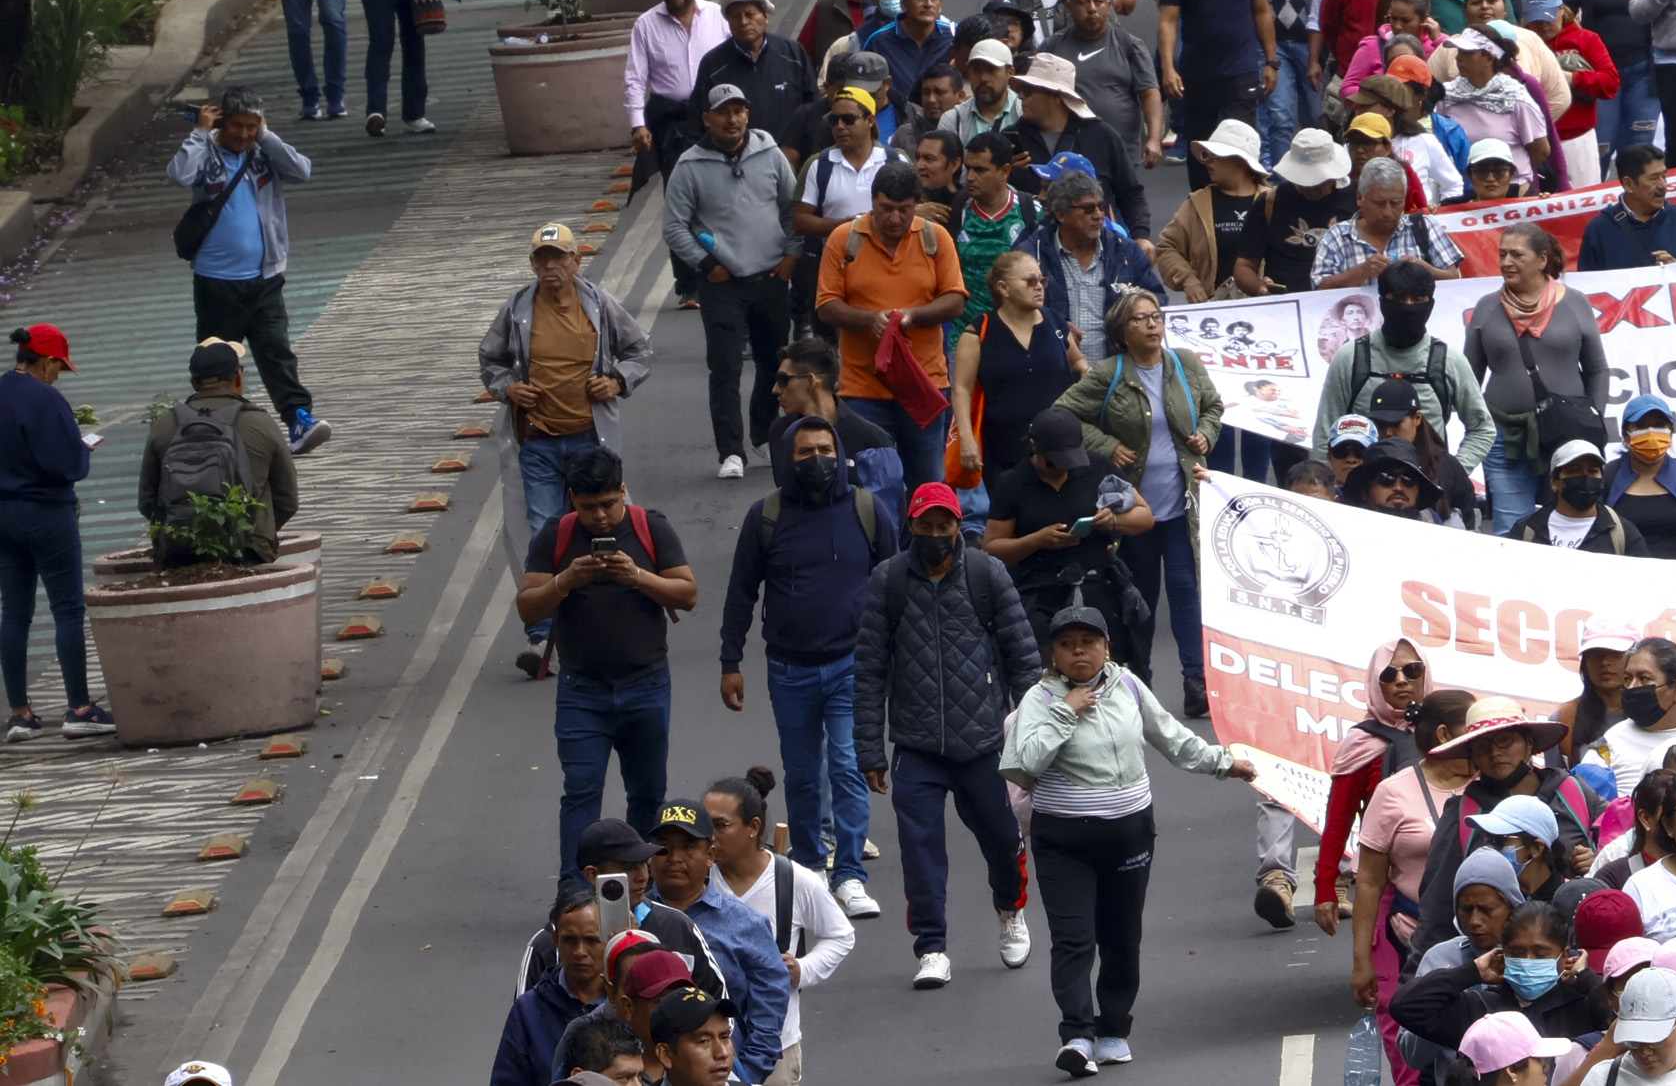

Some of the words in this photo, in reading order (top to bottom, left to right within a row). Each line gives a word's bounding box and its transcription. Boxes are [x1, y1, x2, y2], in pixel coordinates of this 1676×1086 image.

[1263, 497, 1281, 509] AL
[1281, 500, 1331, 541] SERVICIO
[1327, 536, 1343, 556] DEL
[1221, 552, 1242, 578] POR
[1318, 557, 1345, 595] PUEBLO
[661, 806, 697, 821] BXS
